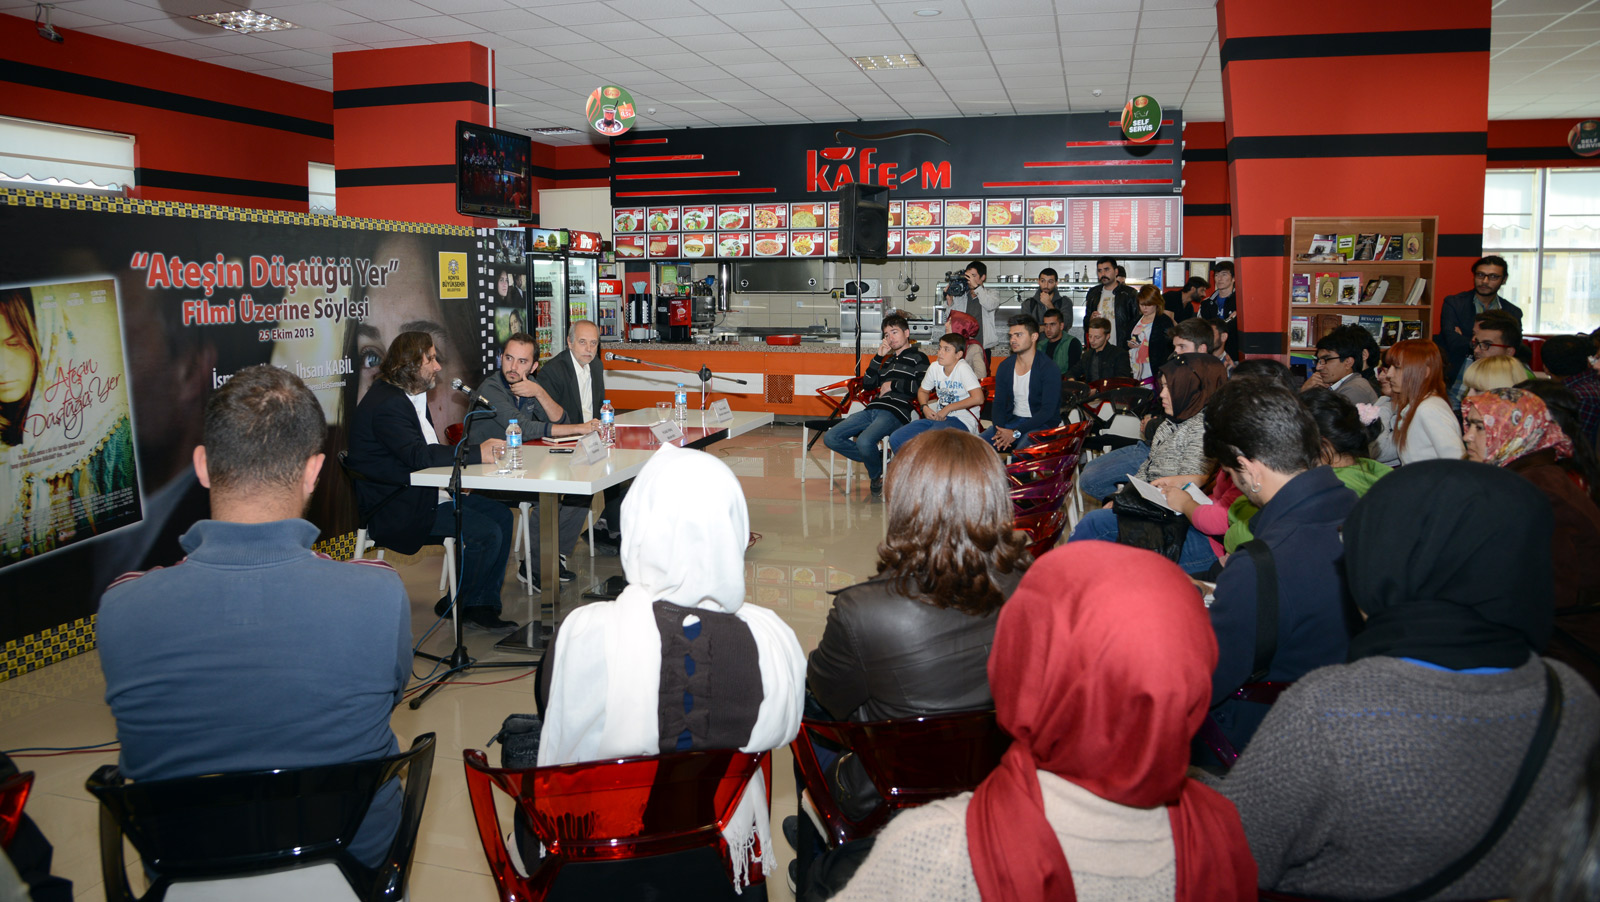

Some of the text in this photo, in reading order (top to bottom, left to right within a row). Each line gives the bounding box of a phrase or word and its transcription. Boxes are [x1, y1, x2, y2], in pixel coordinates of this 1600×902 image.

[1132, 118, 1150, 126] SELF
[250, 255, 353, 294] Düştüğü
[182, 294, 370, 325] Filmi Üzerine Söyleşi
[259, 327, 315, 341] 25 Ekim 2013
[296, 360, 323, 379] İhsan
[326, 355, 354, 376] KABİL
[91, 373, 121, 403] Yer
